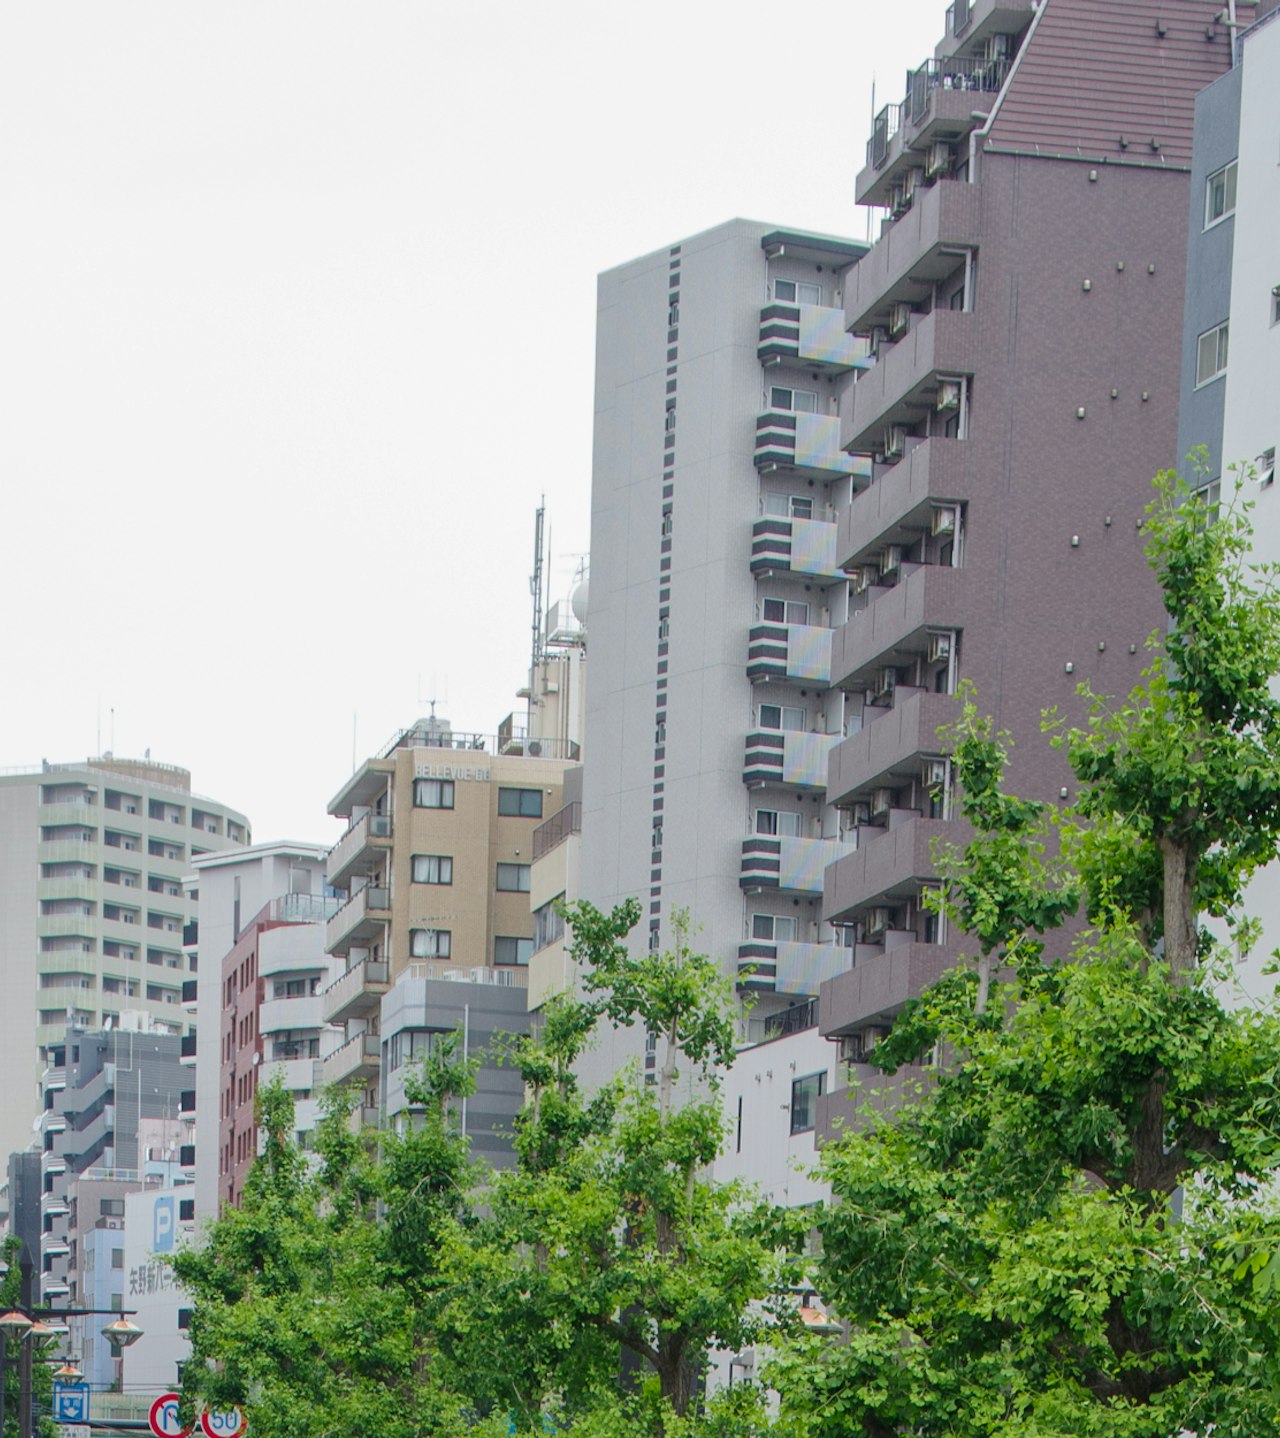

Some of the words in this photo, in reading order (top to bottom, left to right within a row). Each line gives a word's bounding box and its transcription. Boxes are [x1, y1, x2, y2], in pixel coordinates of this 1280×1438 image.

[416, 763, 471, 781] BELLEVUE
[156, 1206, 171, 1244] P
[212, 1407, 237, 1430] 50
